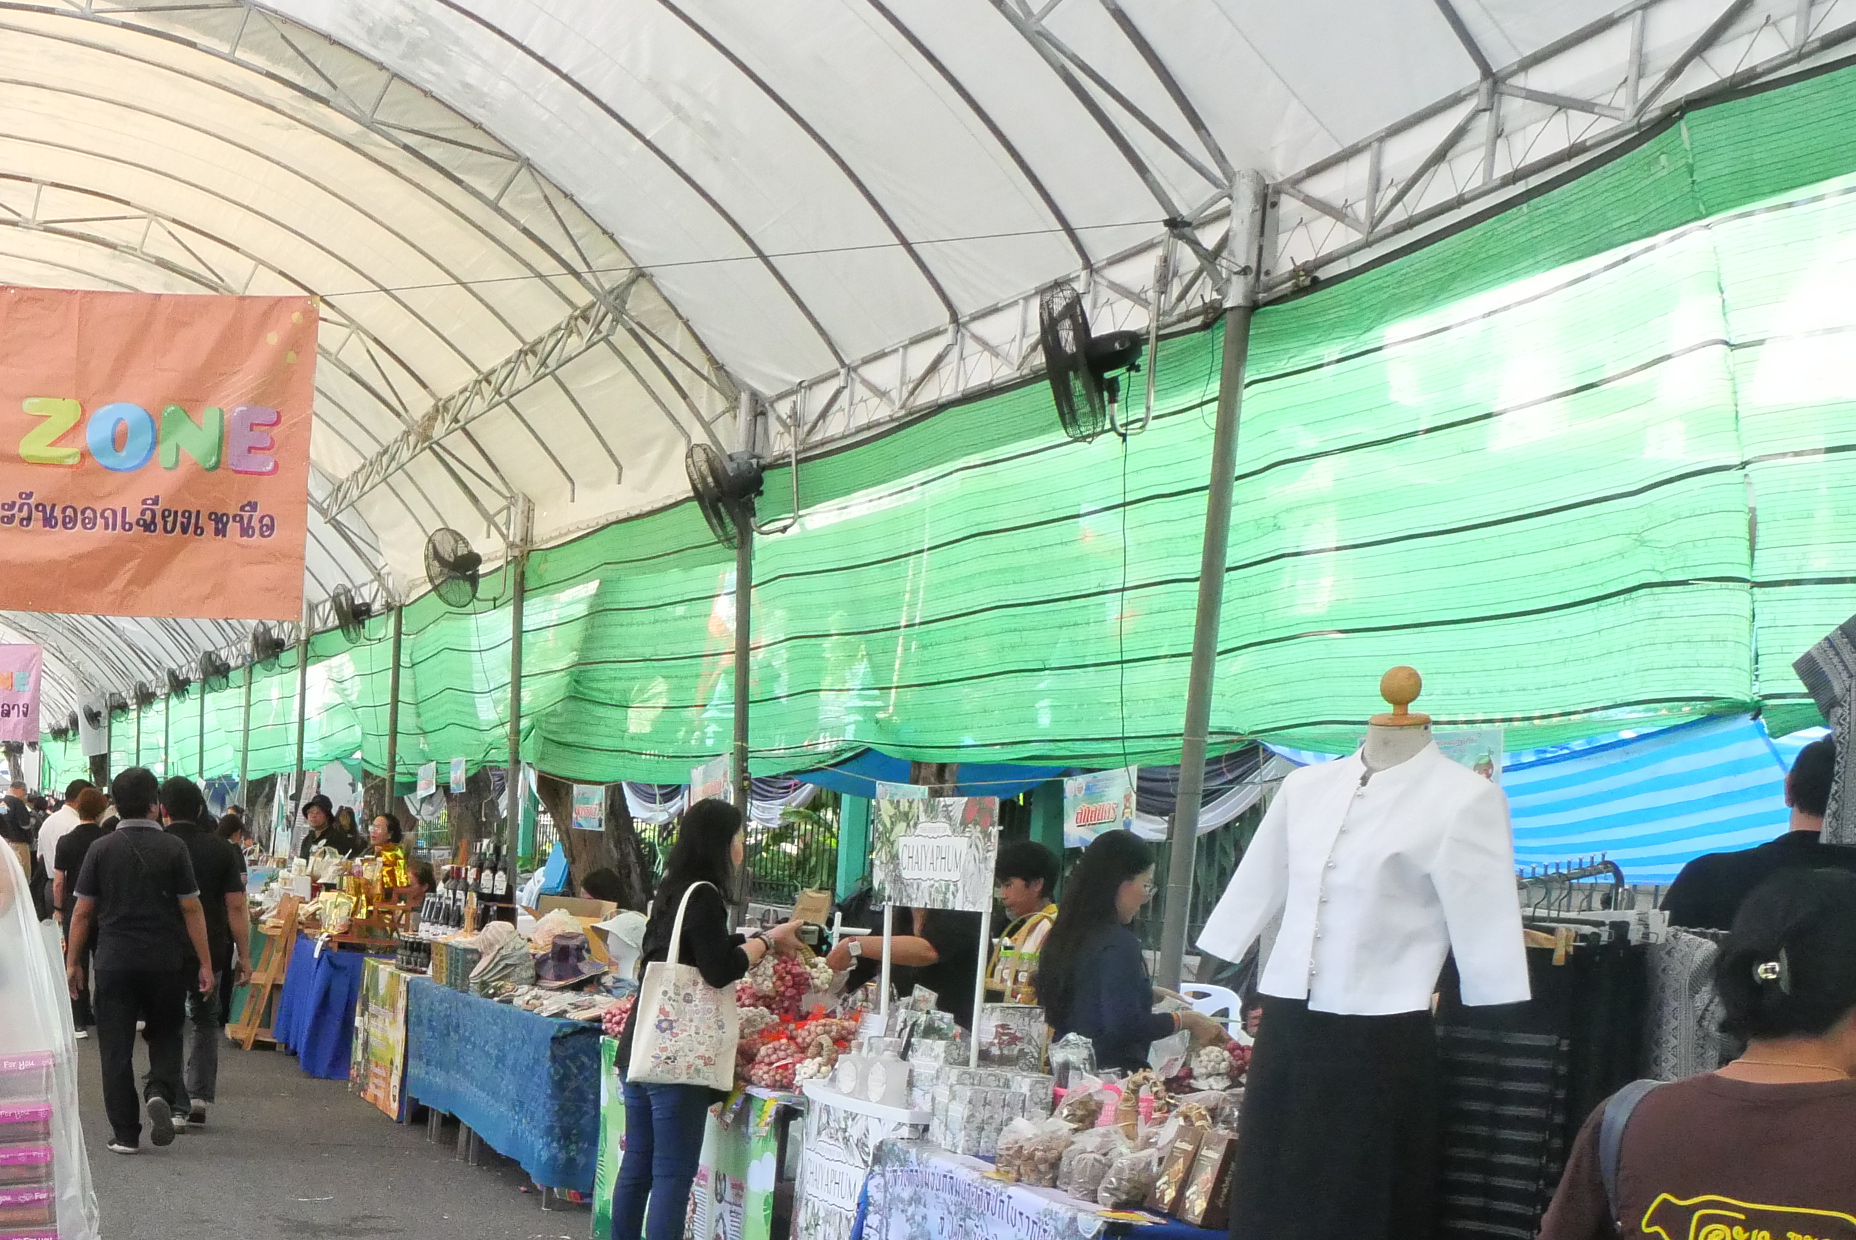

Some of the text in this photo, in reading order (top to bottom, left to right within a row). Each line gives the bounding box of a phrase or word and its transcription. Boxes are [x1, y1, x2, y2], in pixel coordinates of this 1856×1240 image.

[17, 397, 281, 478] ZONE
[901, 843, 962, 873] CHAIYAPHUM
[18, 1059, 34, 1071] you
[35, 1192, 48, 1200] For
